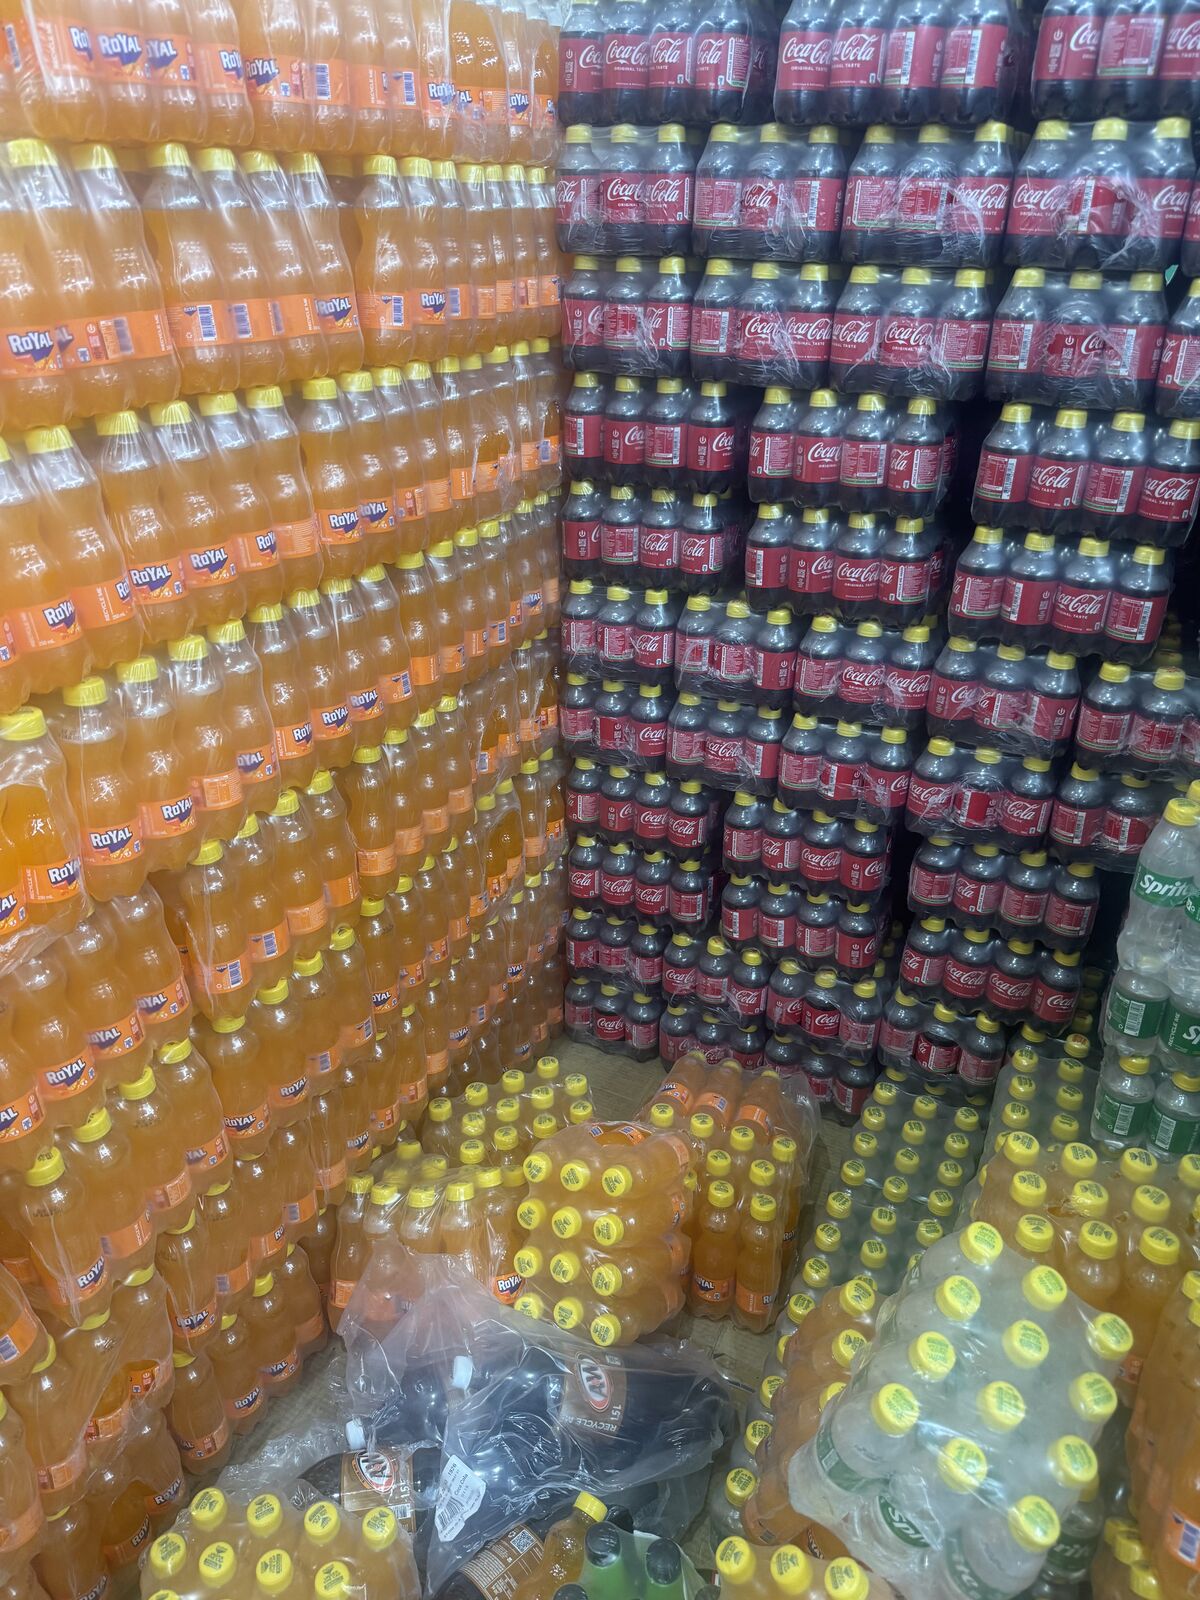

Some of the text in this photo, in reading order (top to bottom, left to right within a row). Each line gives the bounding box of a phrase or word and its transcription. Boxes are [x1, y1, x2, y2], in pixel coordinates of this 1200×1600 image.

[652, 37, 684, 63] Cola
[650, 178, 683, 202] Cola
[1012, 183, 1064, 212] Coca-Co
[641, 533, 671, 552] Cola
[682, 537, 707, 557] Cola
[635, 634, 662, 652] Cola
[1168, 1012, 1180, 1048] RECYCLE ME
[610, 1403, 623, 1422] 1.5L
[576, 1416, 617, 1432] RECYCLE
[454, 1473, 469, 1496] Coca Cola
